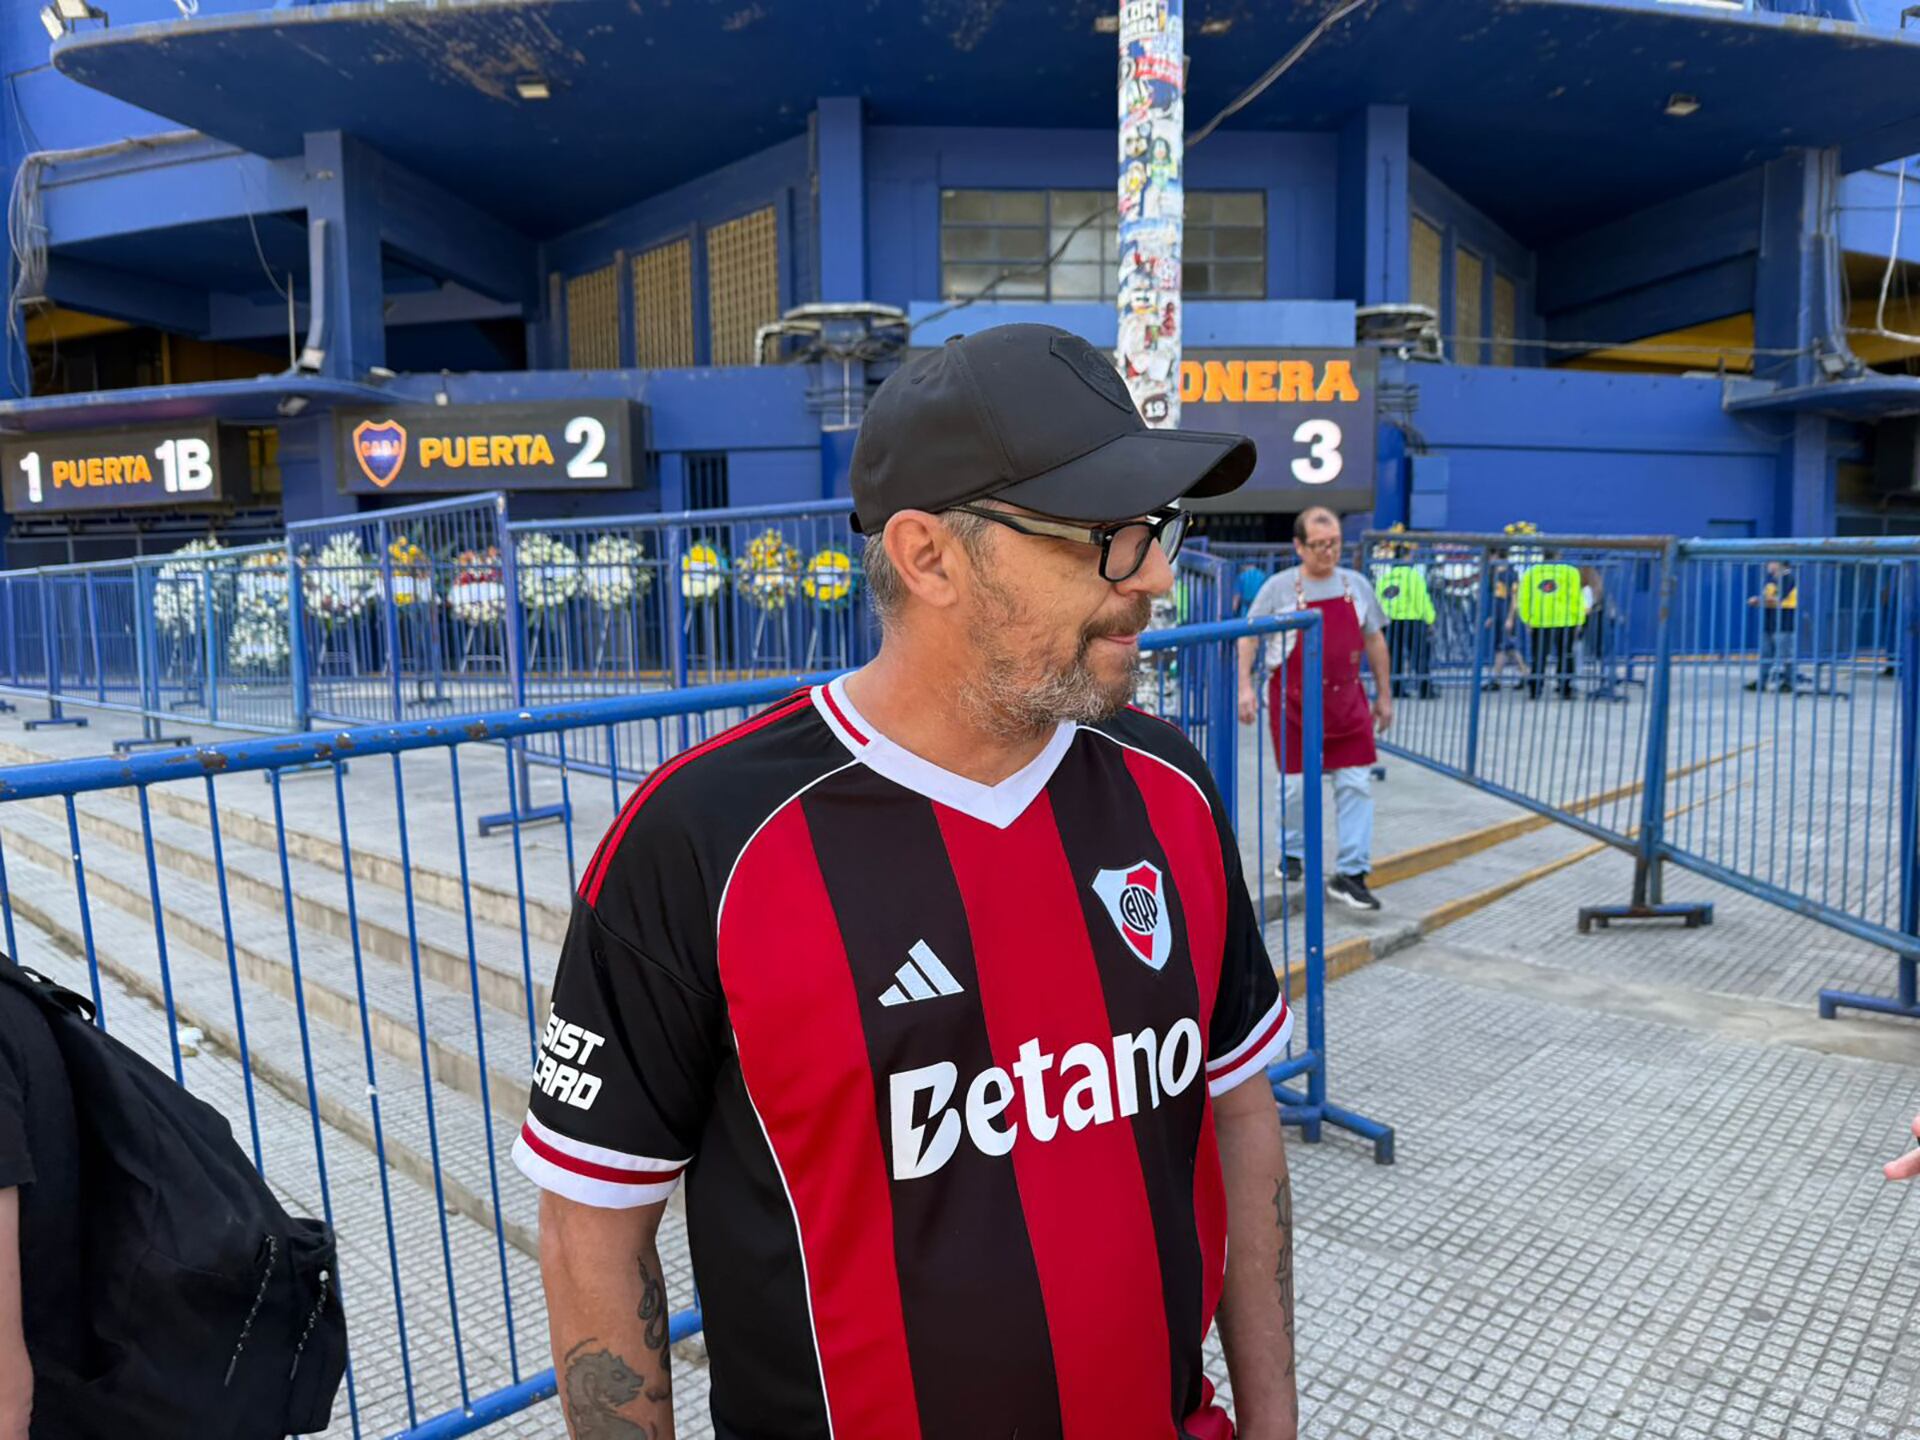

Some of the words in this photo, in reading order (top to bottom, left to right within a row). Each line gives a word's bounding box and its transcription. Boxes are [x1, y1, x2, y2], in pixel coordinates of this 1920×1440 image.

[1179, 359, 1360, 402] ONERA
[20, 451, 43, 503] 1
[52, 455, 152, 489] PUERTA
[154, 438, 213, 493] 1B
[419, 434, 555, 469] PUERTA
[564, 416, 608, 478] 2
[1290, 418, 1343, 484] 3
[889, 1017, 1202, 1181] Betano
